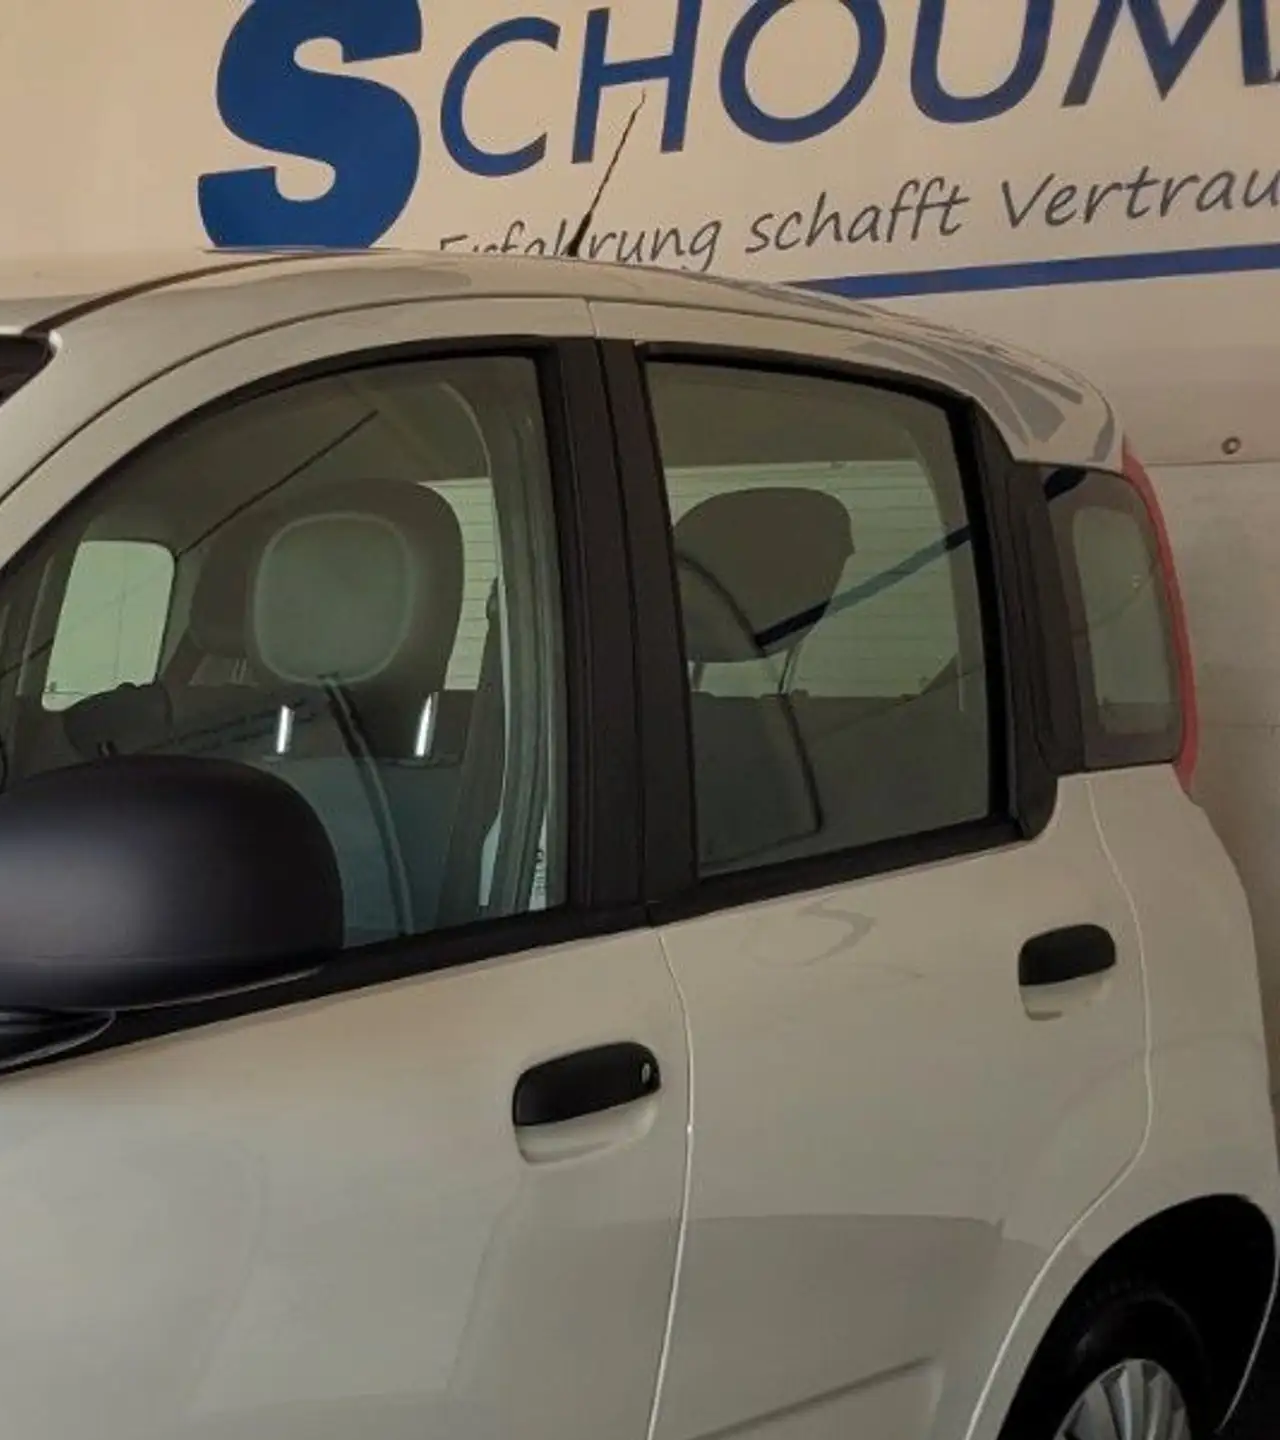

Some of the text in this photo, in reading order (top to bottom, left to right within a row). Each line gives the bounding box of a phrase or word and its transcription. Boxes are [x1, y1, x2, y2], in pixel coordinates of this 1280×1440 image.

[197, 0, 1280, 250] SCHOUM
[744, 176, 970, 254] schafft
[1001, 165, 1280, 229] Vertrau
